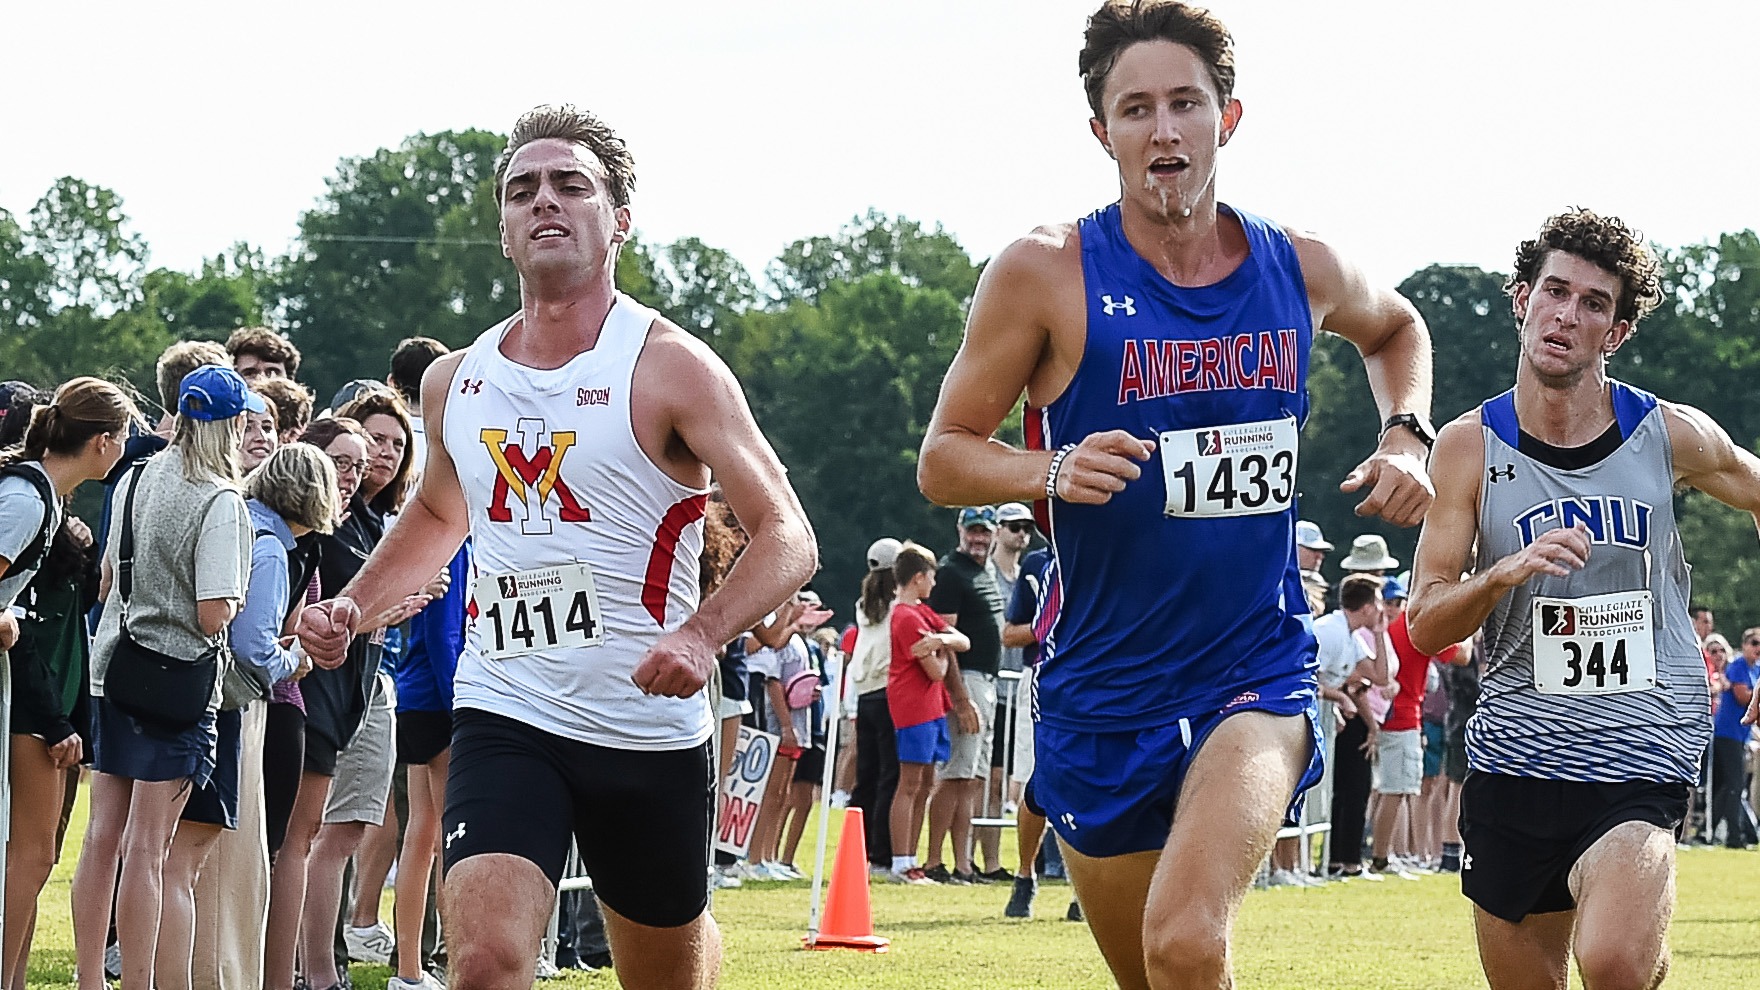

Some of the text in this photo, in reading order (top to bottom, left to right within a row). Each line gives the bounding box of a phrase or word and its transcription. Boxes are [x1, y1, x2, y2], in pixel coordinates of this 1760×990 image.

[1117, 328, 1297, 405] AMERICAN
[1223, 425, 1272, 436] COLLEGIATE
[1224, 432, 1273, 446] RUNNING
[1226, 445, 1274, 454] ASSOCIATION
[1174, 450, 1293, 513] 1433
[518, 576, 562, 590] RUNNING
[1578, 600, 1643, 614] COLLEGIATE
[485, 590, 597, 651] 1414
[1579, 609, 1644, 626] RUNNING
[1580, 625, 1645, 637] ASSOCIATION
[1562, 638, 1629, 688] 344
